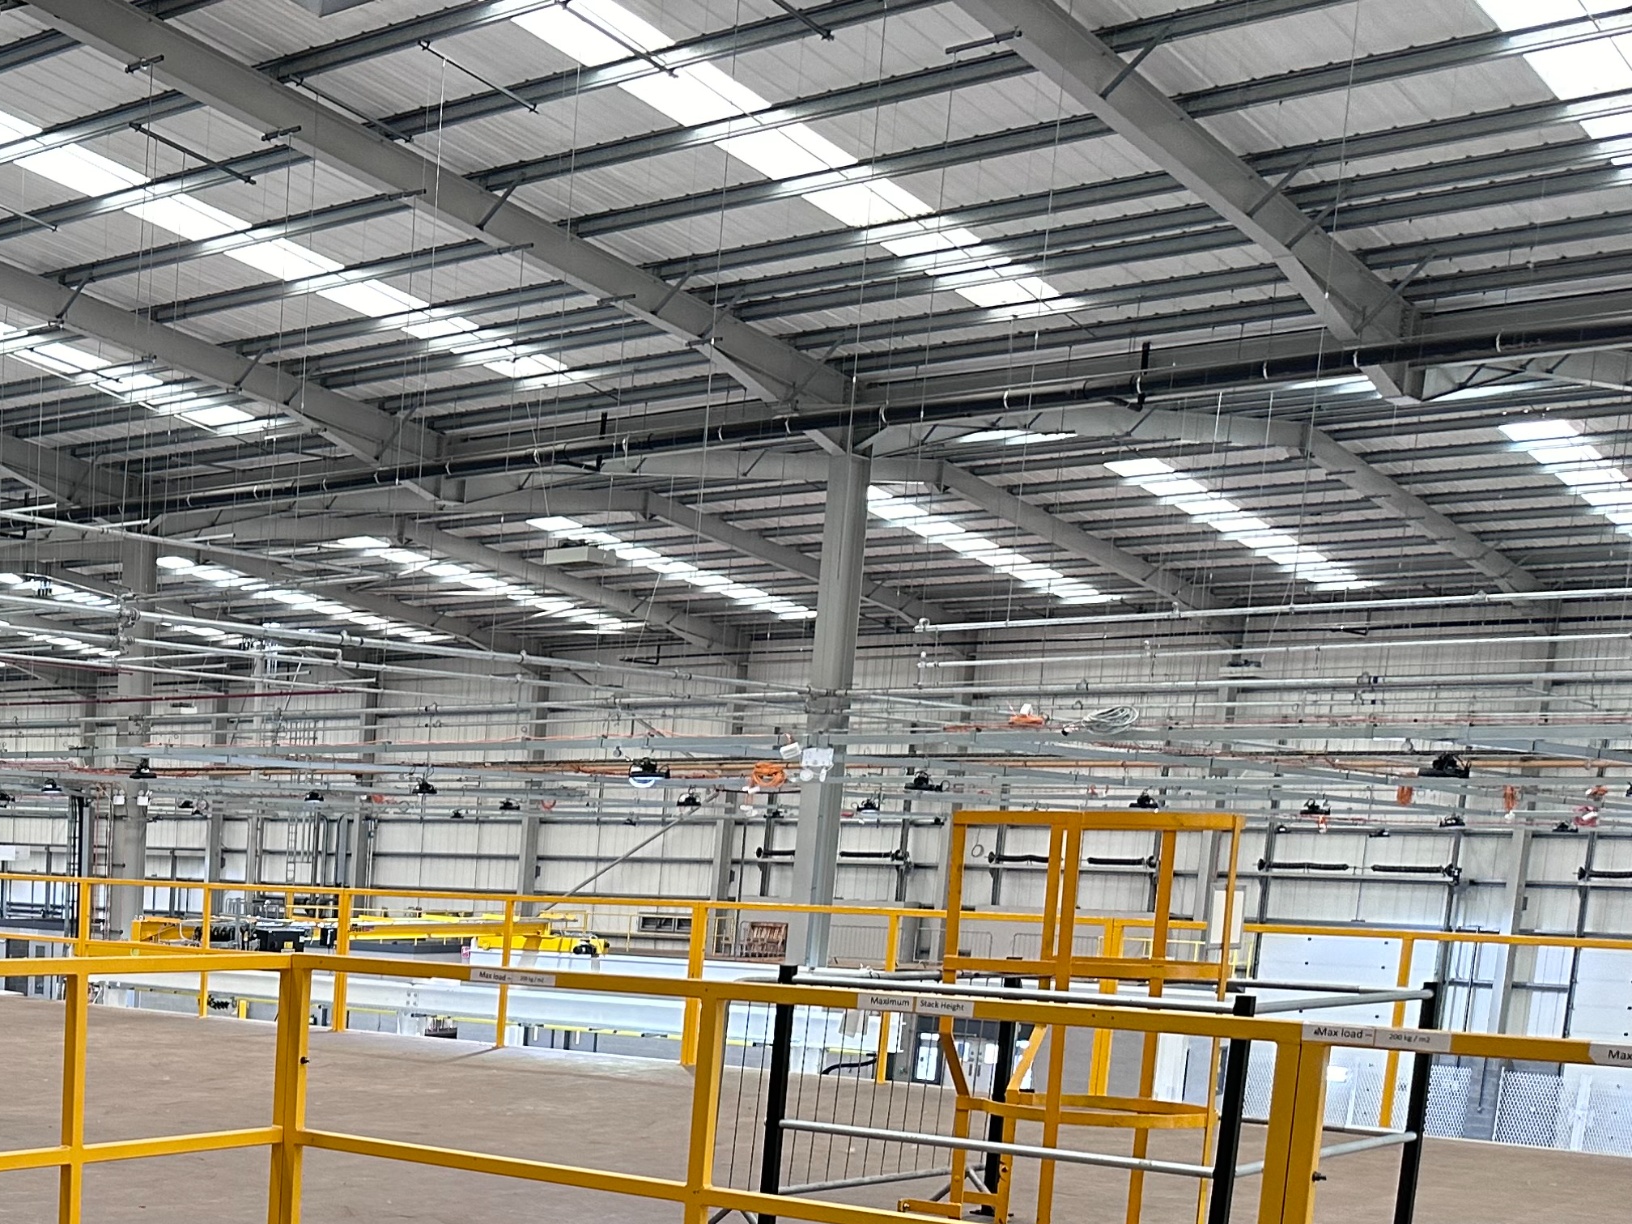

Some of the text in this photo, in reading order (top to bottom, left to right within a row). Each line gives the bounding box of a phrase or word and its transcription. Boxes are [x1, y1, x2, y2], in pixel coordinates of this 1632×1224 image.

[479, 971, 492, 979] Max
[493, 972, 507, 981] load
[870, 996, 965, 1011] Maximum Stack Height
[1317, 1027, 1338, 1037] Max
[1341, 1028, 1363, 1039] load
[1389, 1033, 1402, 1041] 200
[1404, 1034, 1413, 1043] kg
